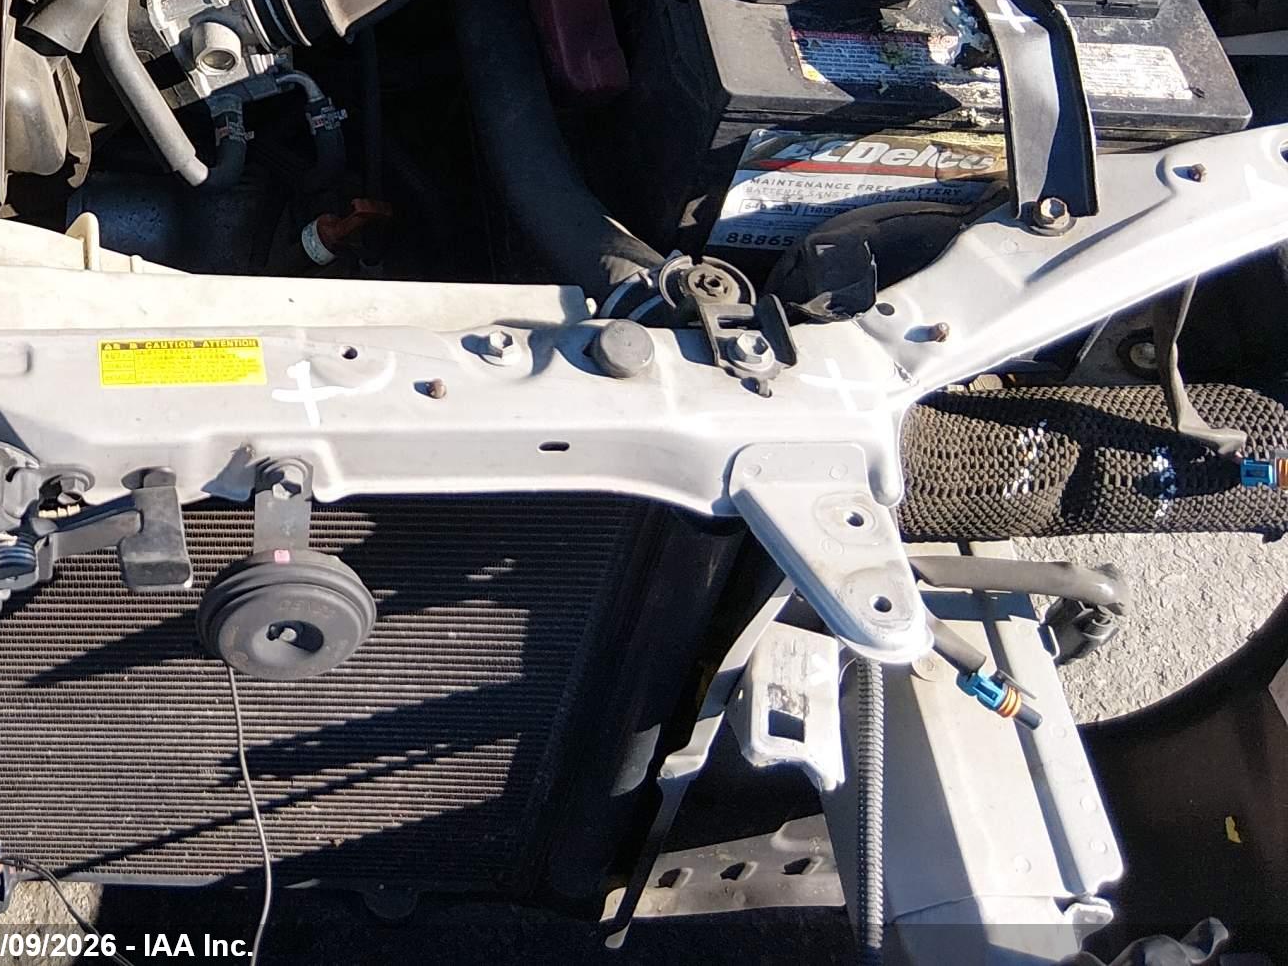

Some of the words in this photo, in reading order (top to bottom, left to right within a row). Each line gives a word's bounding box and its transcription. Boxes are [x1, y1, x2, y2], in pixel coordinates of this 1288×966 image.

[750, 177, 853, 190] MAINTENANCE
[857, 183, 893, 192] FREE
[898, 185, 963, 197] BATTERY
[725, 232, 796, 248] 88865
[144, 340, 195, 350] CAUTION
[200, 338, 257, 349] ATTENTION
